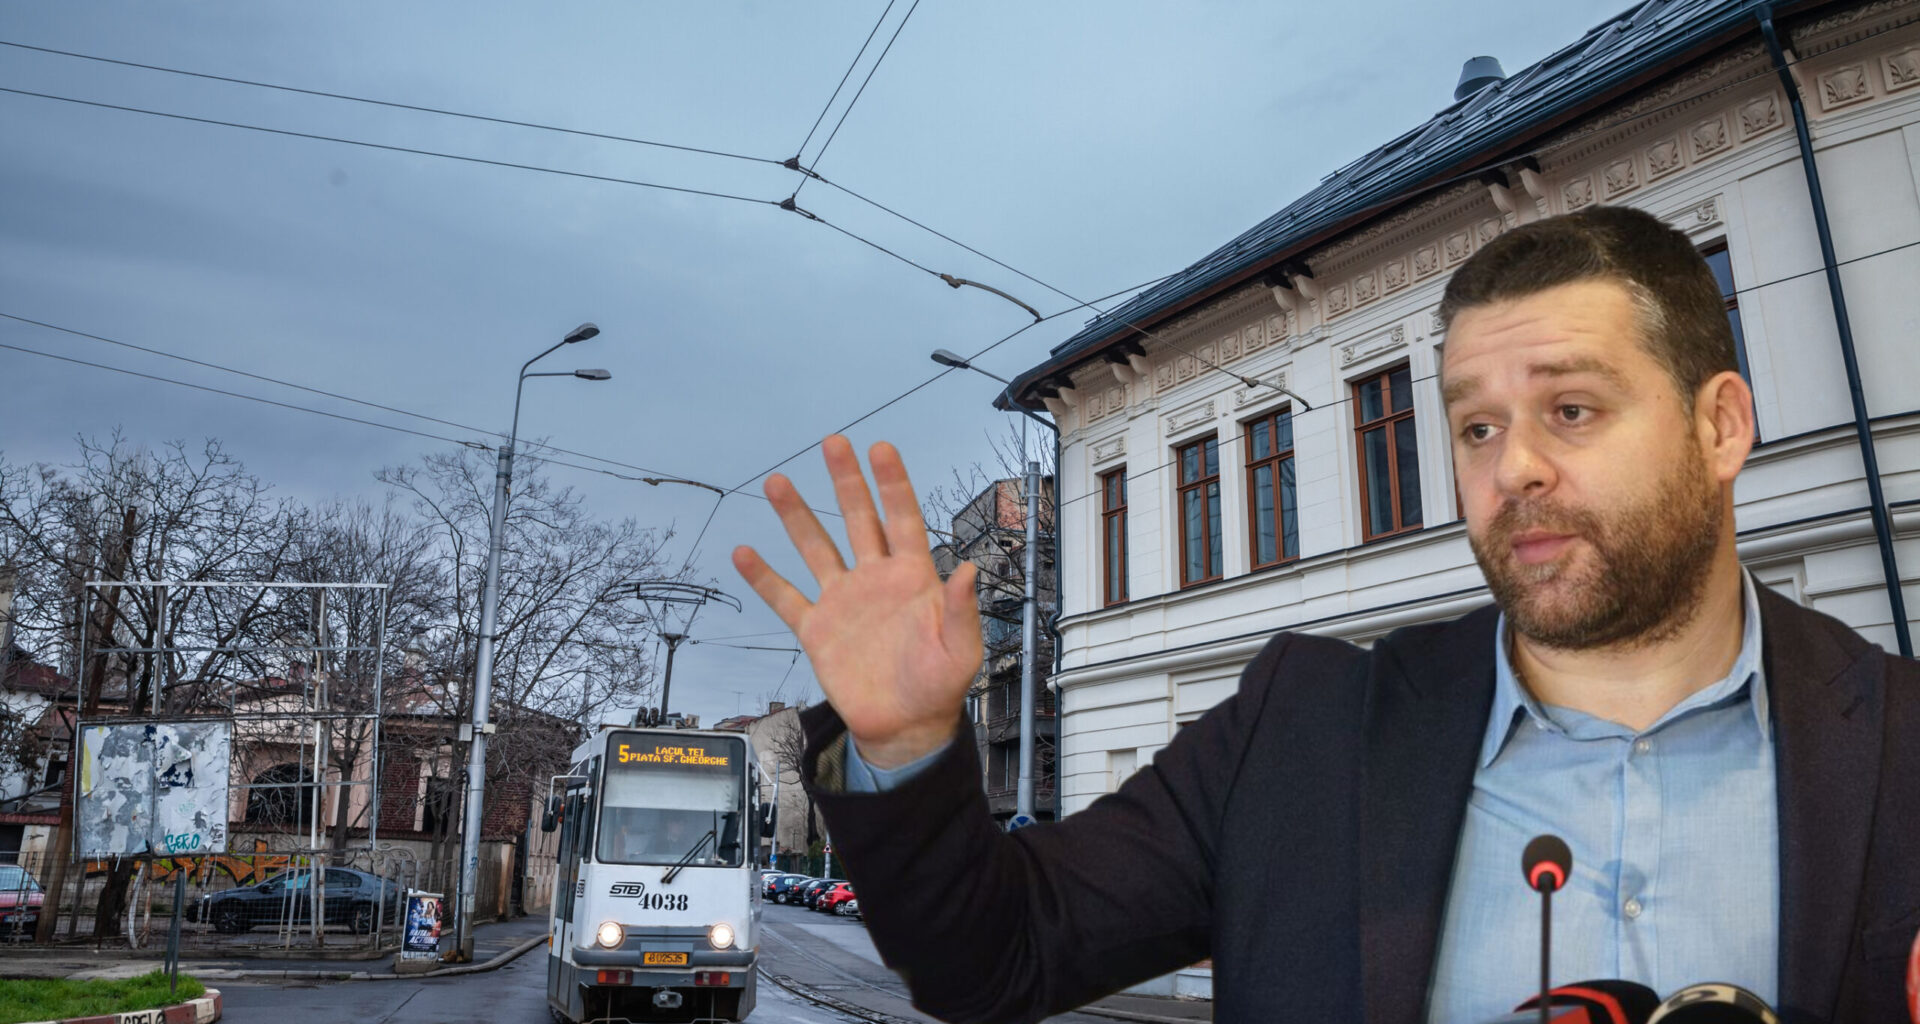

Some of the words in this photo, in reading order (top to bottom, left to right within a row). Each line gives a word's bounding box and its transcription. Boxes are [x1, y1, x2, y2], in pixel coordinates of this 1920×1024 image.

[619, 744, 630, 763] 5
[655, 746, 684, 756] LACUL
[688, 748, 704, 757] TEI
[663, 755, 678, 763] SF.
[680, 755, 728, 766] GHEORGHE
[609, 883, 643, 896] STB
[638, 893, 688, 911] 4038
